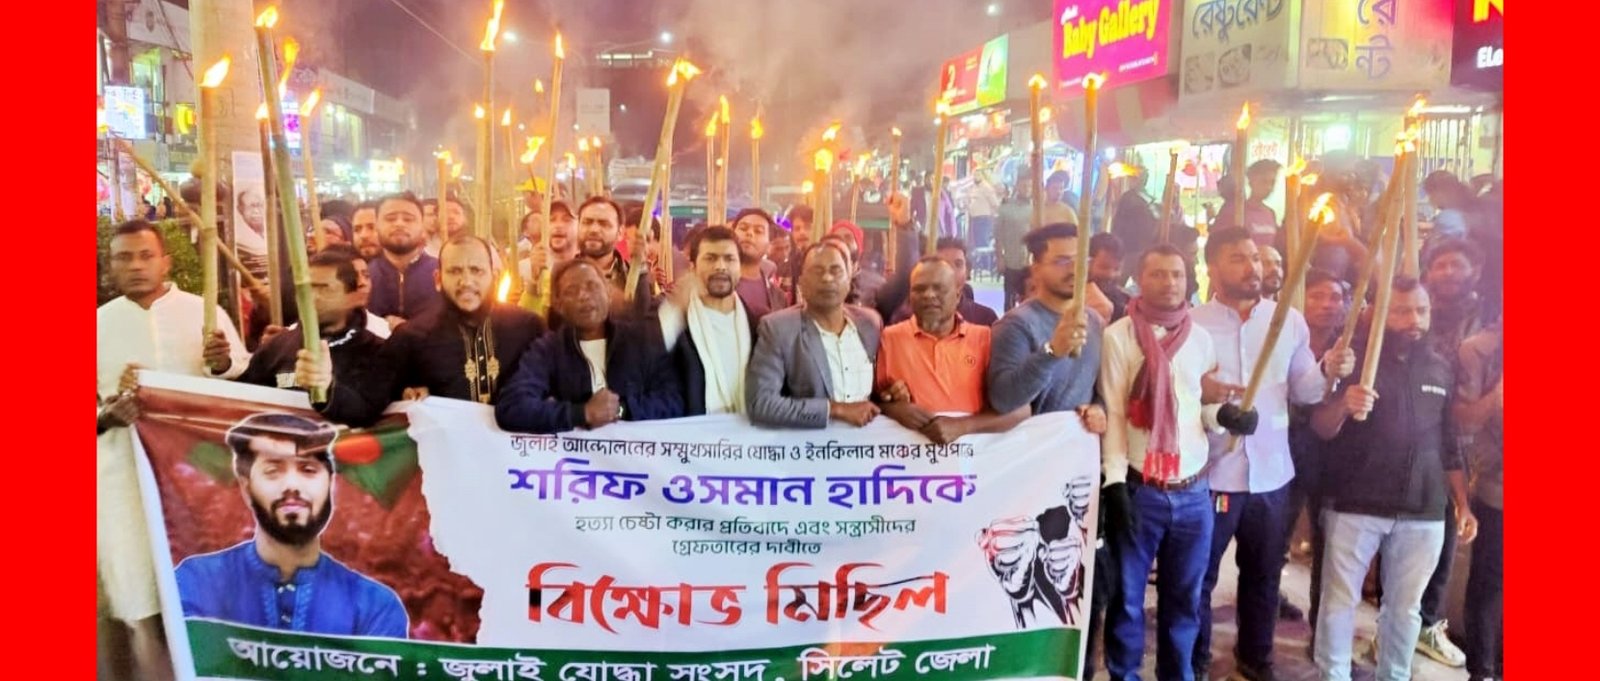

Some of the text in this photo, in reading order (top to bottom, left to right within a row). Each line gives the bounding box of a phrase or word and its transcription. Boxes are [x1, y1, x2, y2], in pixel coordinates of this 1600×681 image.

[1063, 15, 1097, 59] Baby
[1098, 0, 1159, 46] Gallery
[510, 435, 559, 457] জুলাই
[562, 436, 657, 457] আন্দোলনের
[660, 438, 743, 464] সম্মুখসারির
[747, 445, 785, 462] যোদ্ধা
[790, 445, 801, 461] ও
[805, 441, 875, 462] ইনকিলাব
[879, 443, 921, 460] মঞ্চের
[508, 457, 977, 509] শরিফ ওসমান হাদিকে
[575, 512, 917, 538] হত্যা চেষ্টা করার প্রতিবাদে এবং সন্ত্রাসীদের
[672, 538, 822, 556] গ্রেফতারের দাবীতে
[526, 562, 950, 634] বিক্ষোভ মিছিল
[227, 637, 402, 677] আয়োজনে
[437, 652, 547, 681] জুলাই
[559, 660, 658, 681] যোদ্ধা
[796, 646, 906, 681] সিলেট
[915, 643, 996, 673] জেলা
